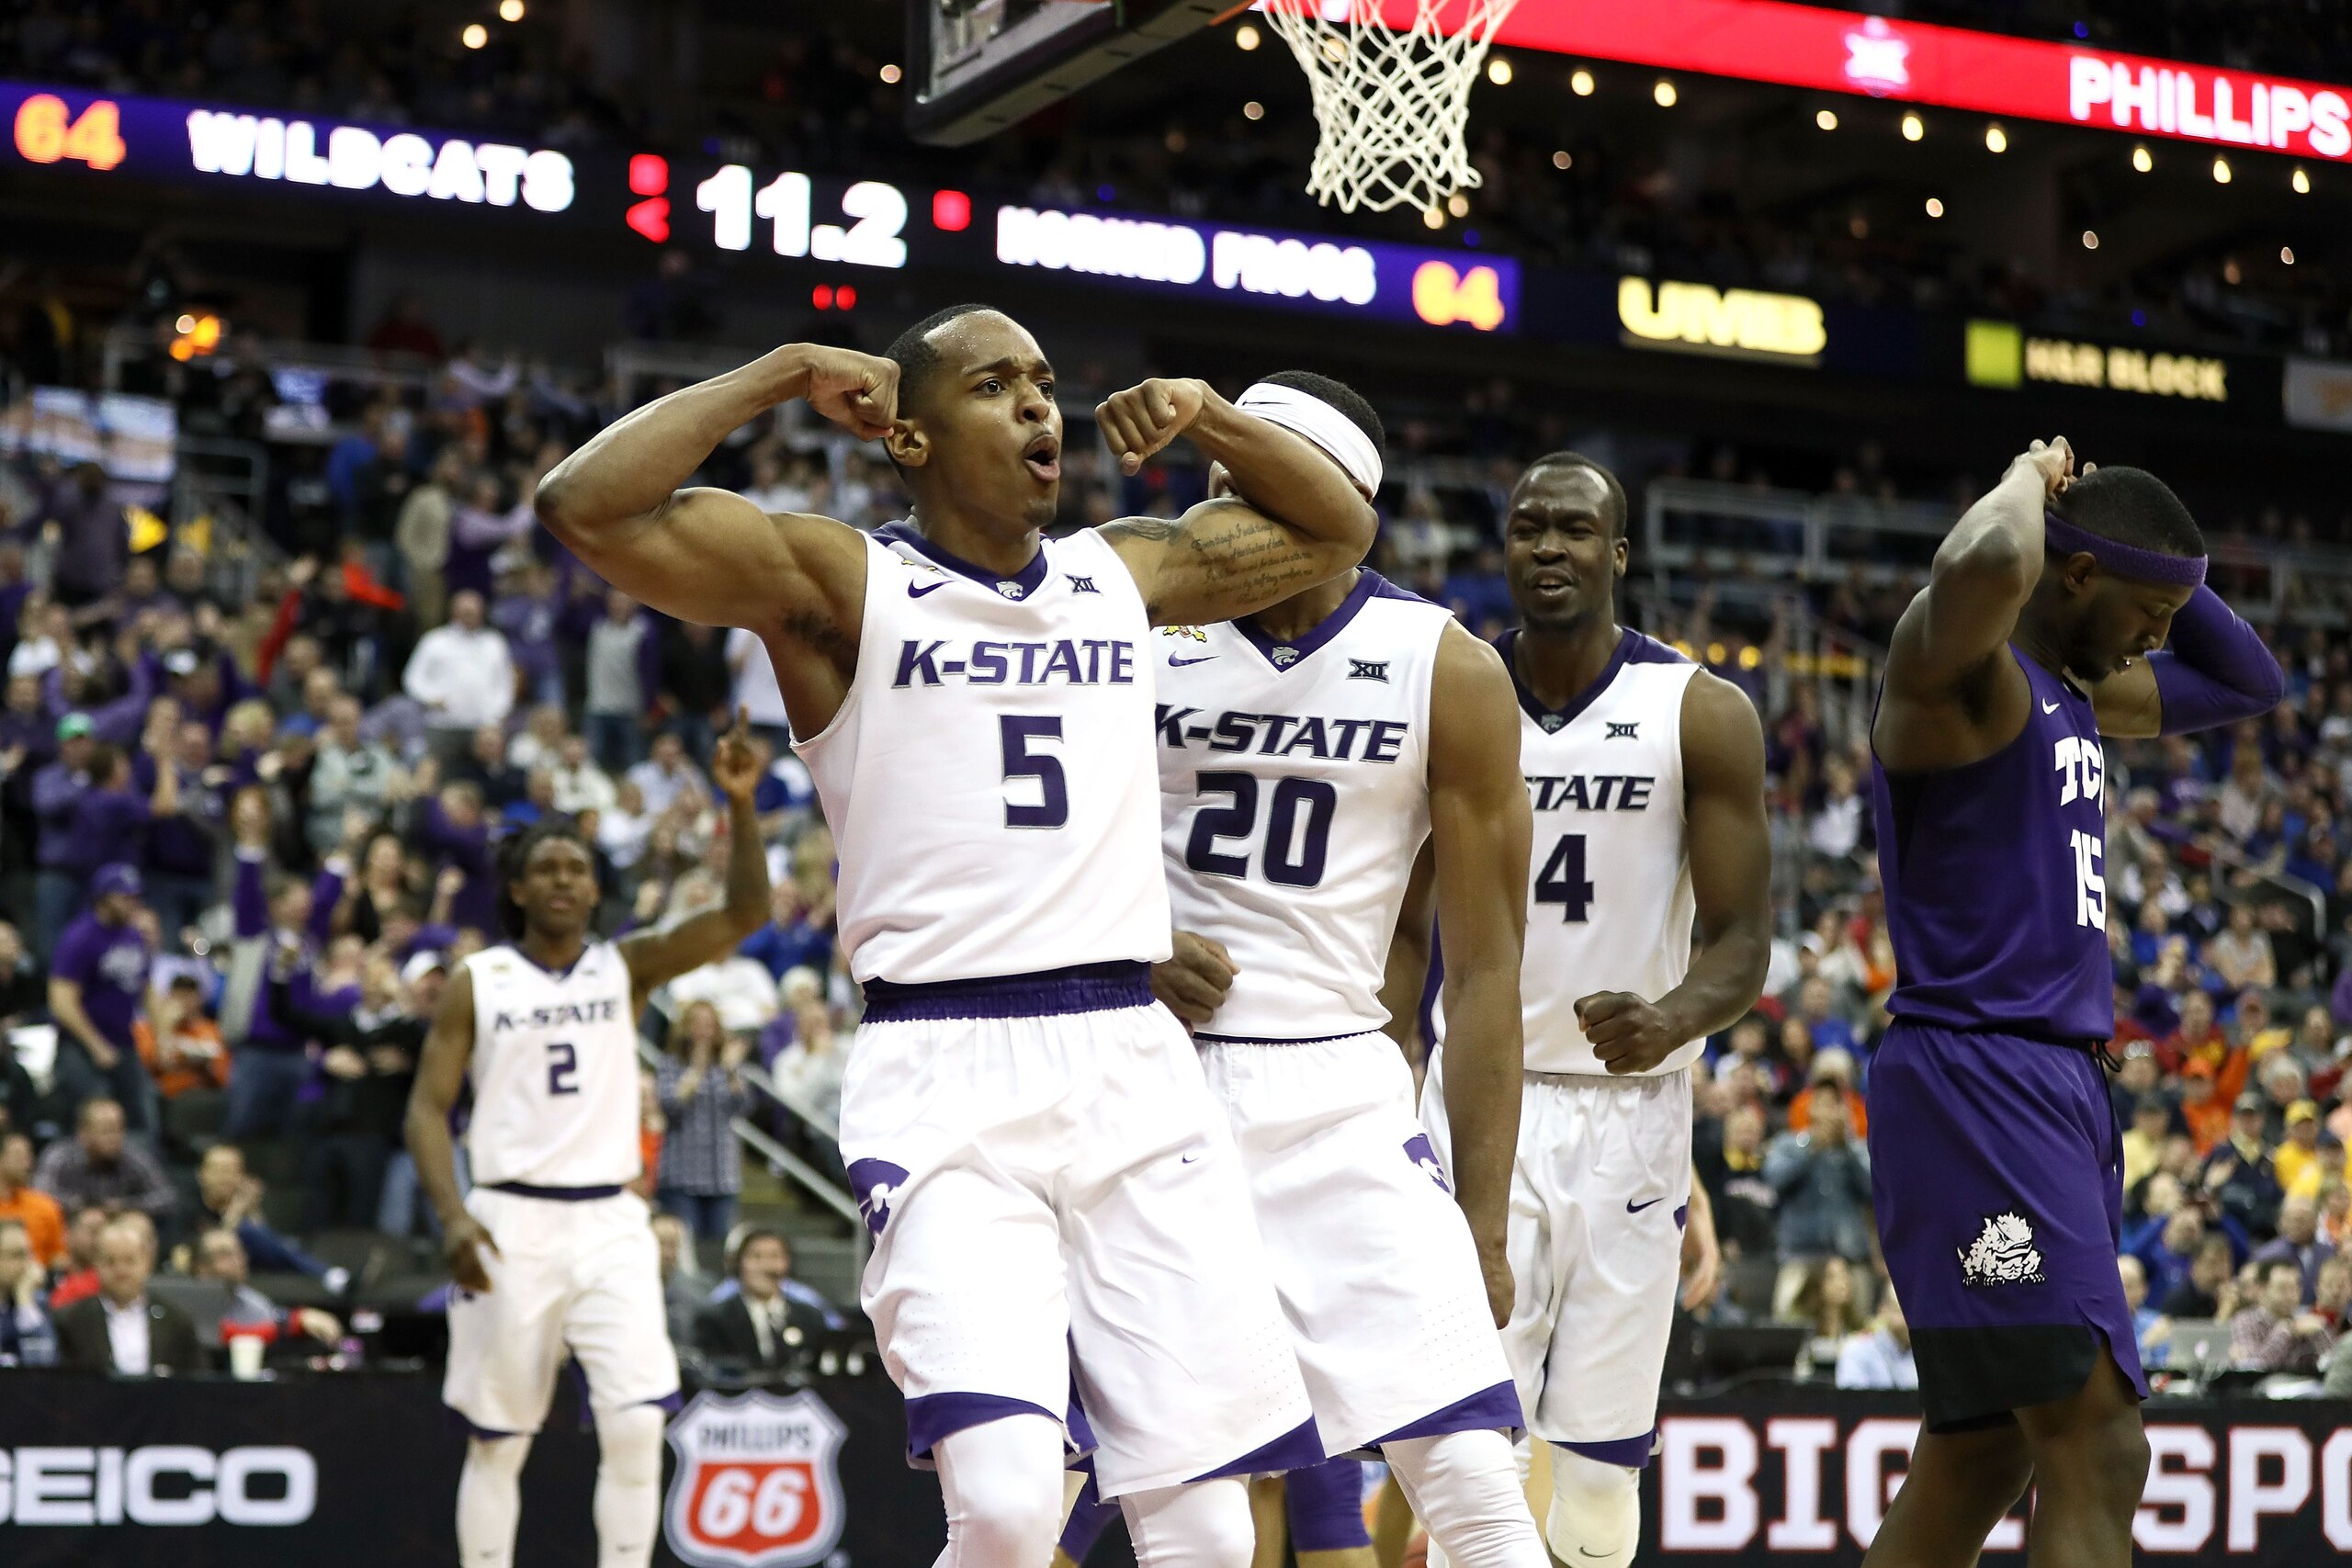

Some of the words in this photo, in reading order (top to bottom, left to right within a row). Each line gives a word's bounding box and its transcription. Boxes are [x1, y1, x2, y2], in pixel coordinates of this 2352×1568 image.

[14, 93, 127, 171] 64
[2069, 55, 2352, 157] PHILLIPS
[187, 108, 575, 212] WILDCATS
[696, 164, 908, 268] 11.2
[1412, 260, 1505, 332] 64
[1618, 276, 1827, 355] UMB
[2107, 345, 2229, 402] BLOCK
[891, 638, 1135, 690] K-STATE
[1346, 657, 1391, 684] XII
[1154, 703, 1409, 764] K-STATE
[997, 714, 1069, 829] 5
[1524, 774, 1656, 811] TATE
[1185, 770, 1338, 889] 20
[1533, 833, 1595, 924] 4
[2070, 829, 2106, 933] 15
[494, 998, 618, 1033] K-STATE
[547, 1043, 579, 1096] 2
[699, 1426, 810, 1449] PHILLIPS
[0, 1445, 319, 1527] EICO
[698, 1469, 808, 1538] 66
